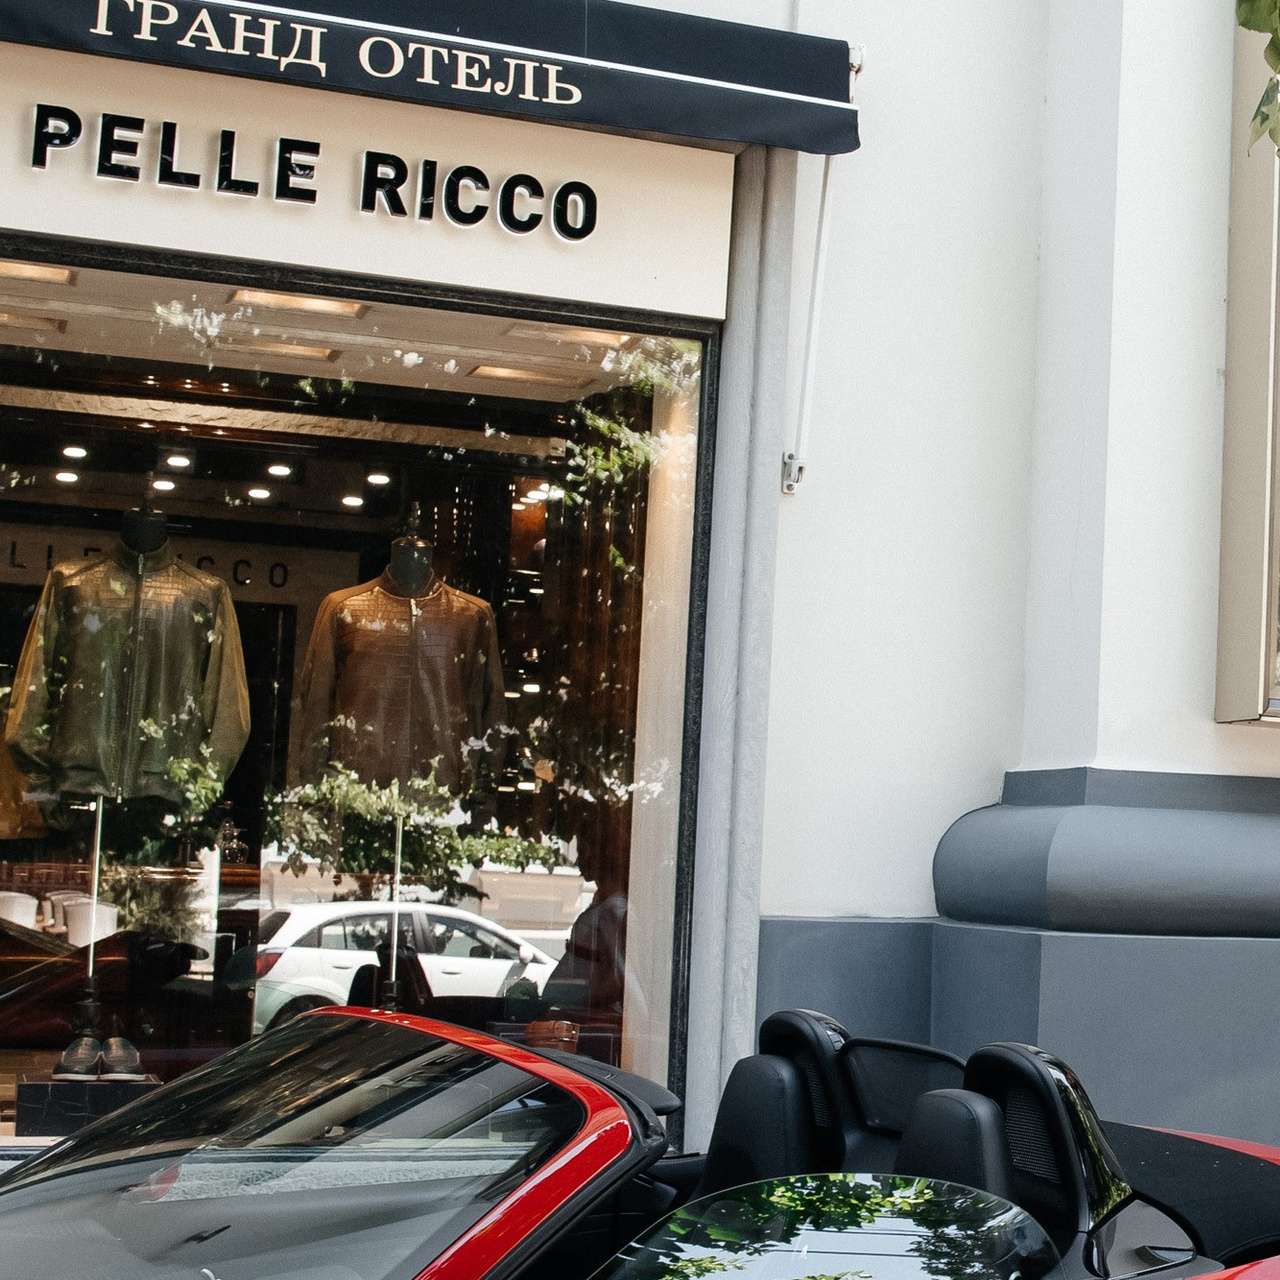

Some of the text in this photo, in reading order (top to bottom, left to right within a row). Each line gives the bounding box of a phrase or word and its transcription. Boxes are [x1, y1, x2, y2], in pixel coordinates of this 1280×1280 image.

[358, 35, 583, 106] ОТЕЛЬ
[31, 103, 598, 242] PELLE RICCO
